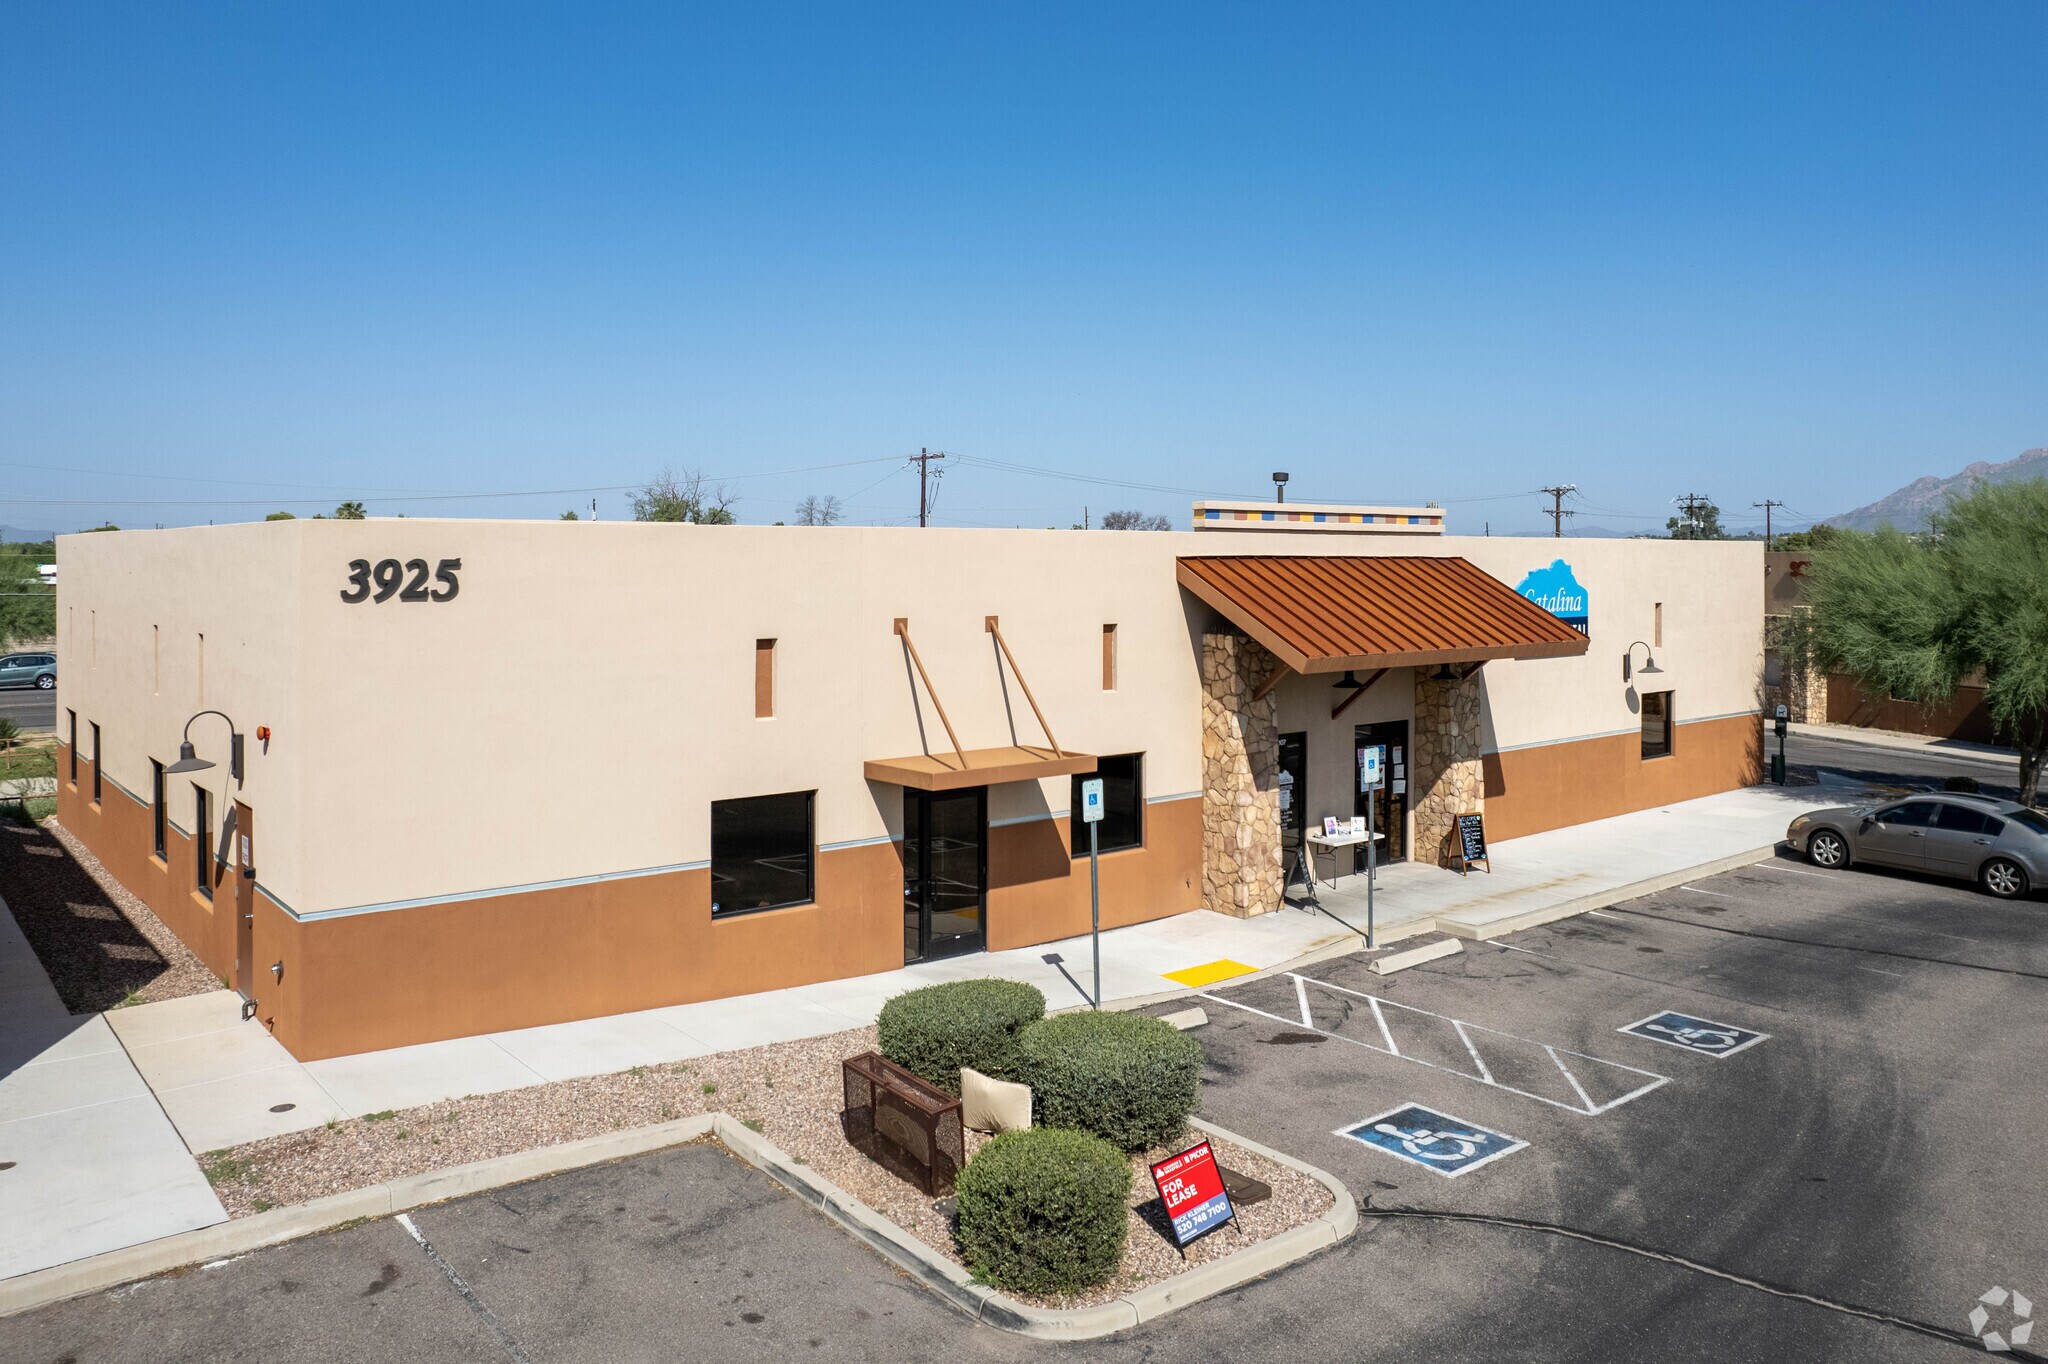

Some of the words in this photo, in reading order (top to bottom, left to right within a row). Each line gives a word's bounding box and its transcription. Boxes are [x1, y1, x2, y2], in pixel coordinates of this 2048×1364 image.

[340, 557, 462, 604] 3925
[1189, 1146, 1209, 1161] PICOR
[1162, 1178, 1184, 1197] FOR
[1166, 1184, 1198, 1208] LEASE
[1175, 1215, 1188, 1225] RICK
[1177, 1221, 1193, 1234] 520
[1193, 1212, 1208, 1226] 748
[1207, 1202, 1226, 1217] 7100
